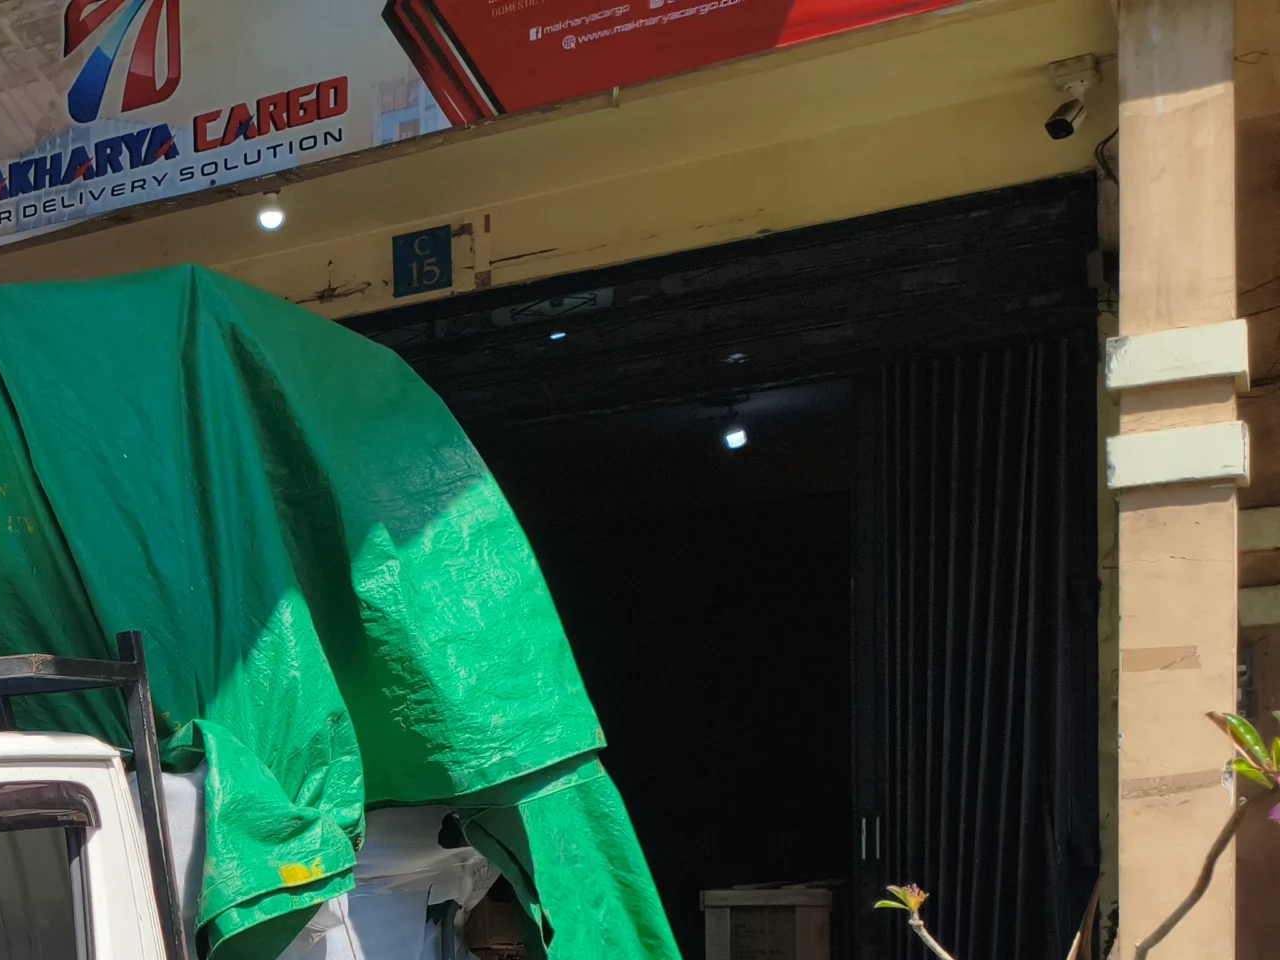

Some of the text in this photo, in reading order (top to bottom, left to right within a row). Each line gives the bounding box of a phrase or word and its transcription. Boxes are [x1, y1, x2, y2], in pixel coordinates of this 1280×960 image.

[543, 5, 631, 35] makharyacargo
[577, 0, 742, 44] www.makharyacargo.co
[192, 75, 350, 153] CARGO
[21, 174, 170, 221] DELIVERY
[178, 127, 346, 183] SOLUTION
[413, 235, 429, 256] C
[407, 257, 441, 289] 15
